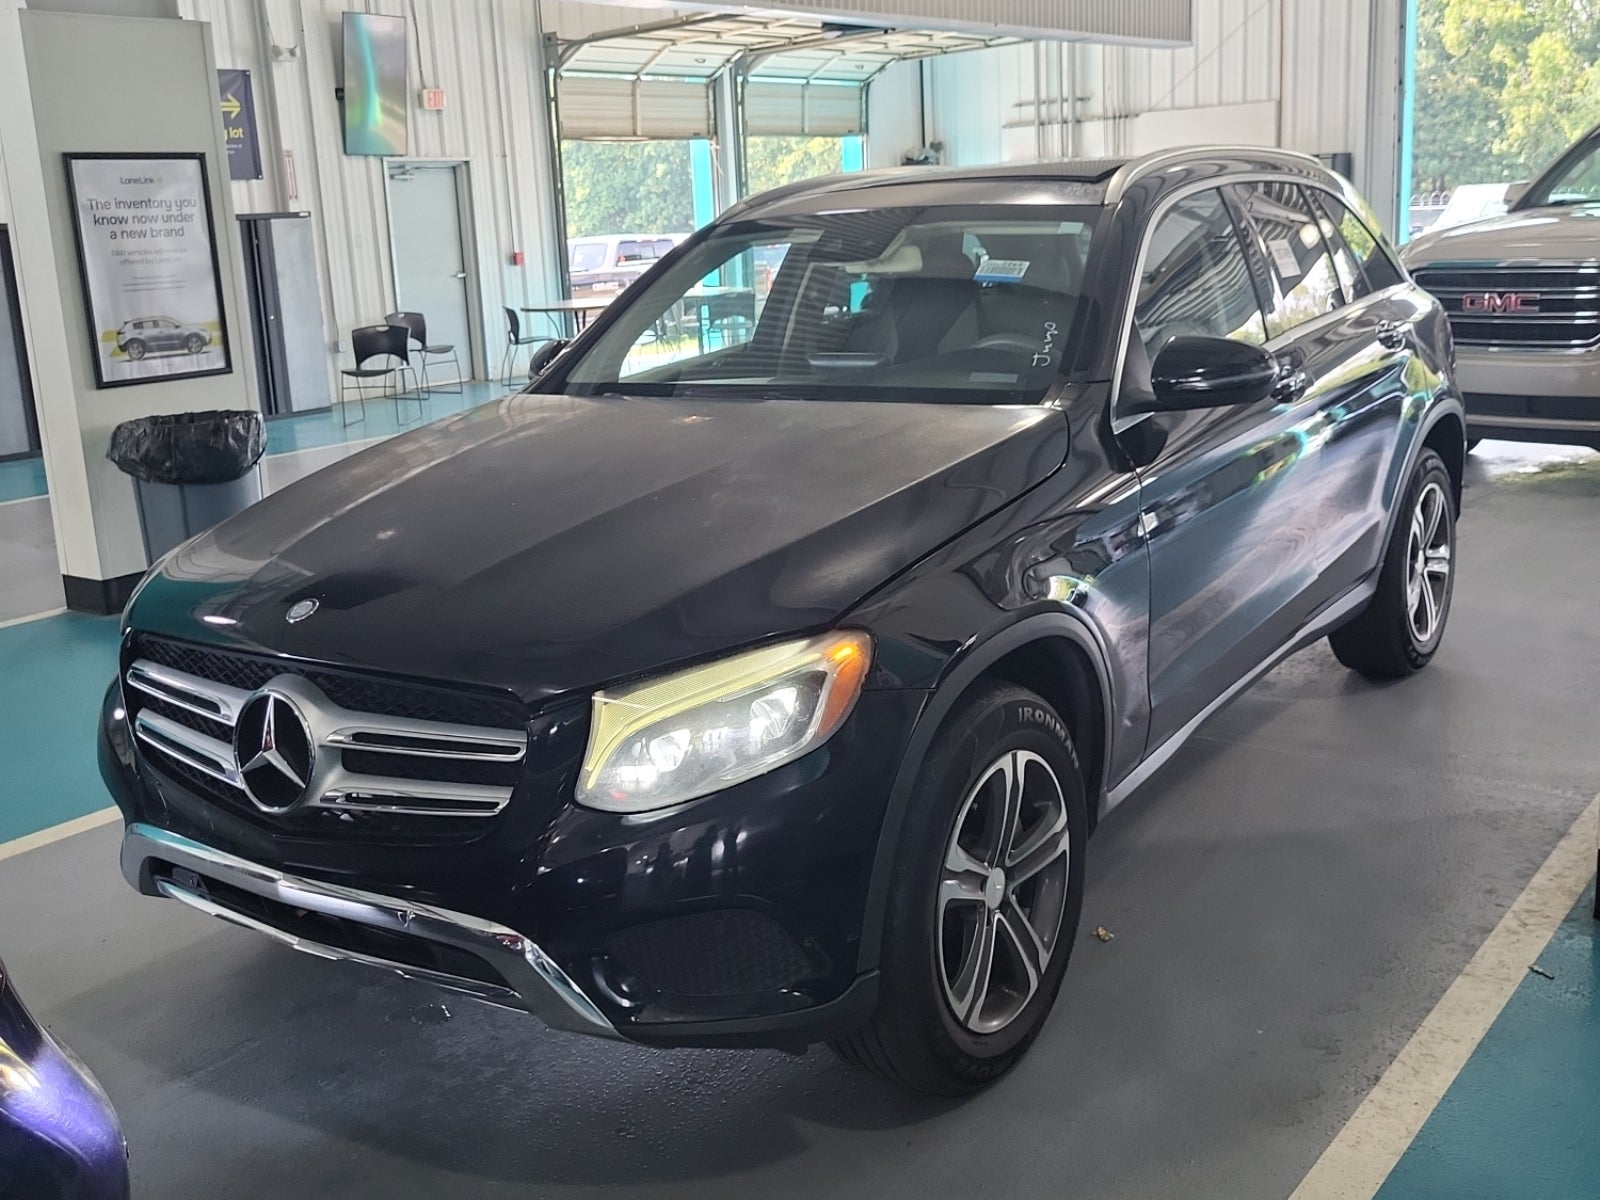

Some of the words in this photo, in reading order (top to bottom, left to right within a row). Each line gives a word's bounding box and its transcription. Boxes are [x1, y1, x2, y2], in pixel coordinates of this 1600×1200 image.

[428, 91, 443, 107] EXIT
[229, 127, 244, 138] lot
[87, 198, 111, 210] The
[114, 197, 172, 212] inventory
[174, 198, 196, 211] you
[93, 213, 128, 226] know
[132, 213, 158, 224] now
[161, 211, 194, 224] under
[110, 230, 117, 240] a
[120, 229, 147, 239] new
[150, 226, 185, 238] brand
[1462, 292, 1541, 313] GMC
[1018, 706, 1080, 769] IRONMAN
